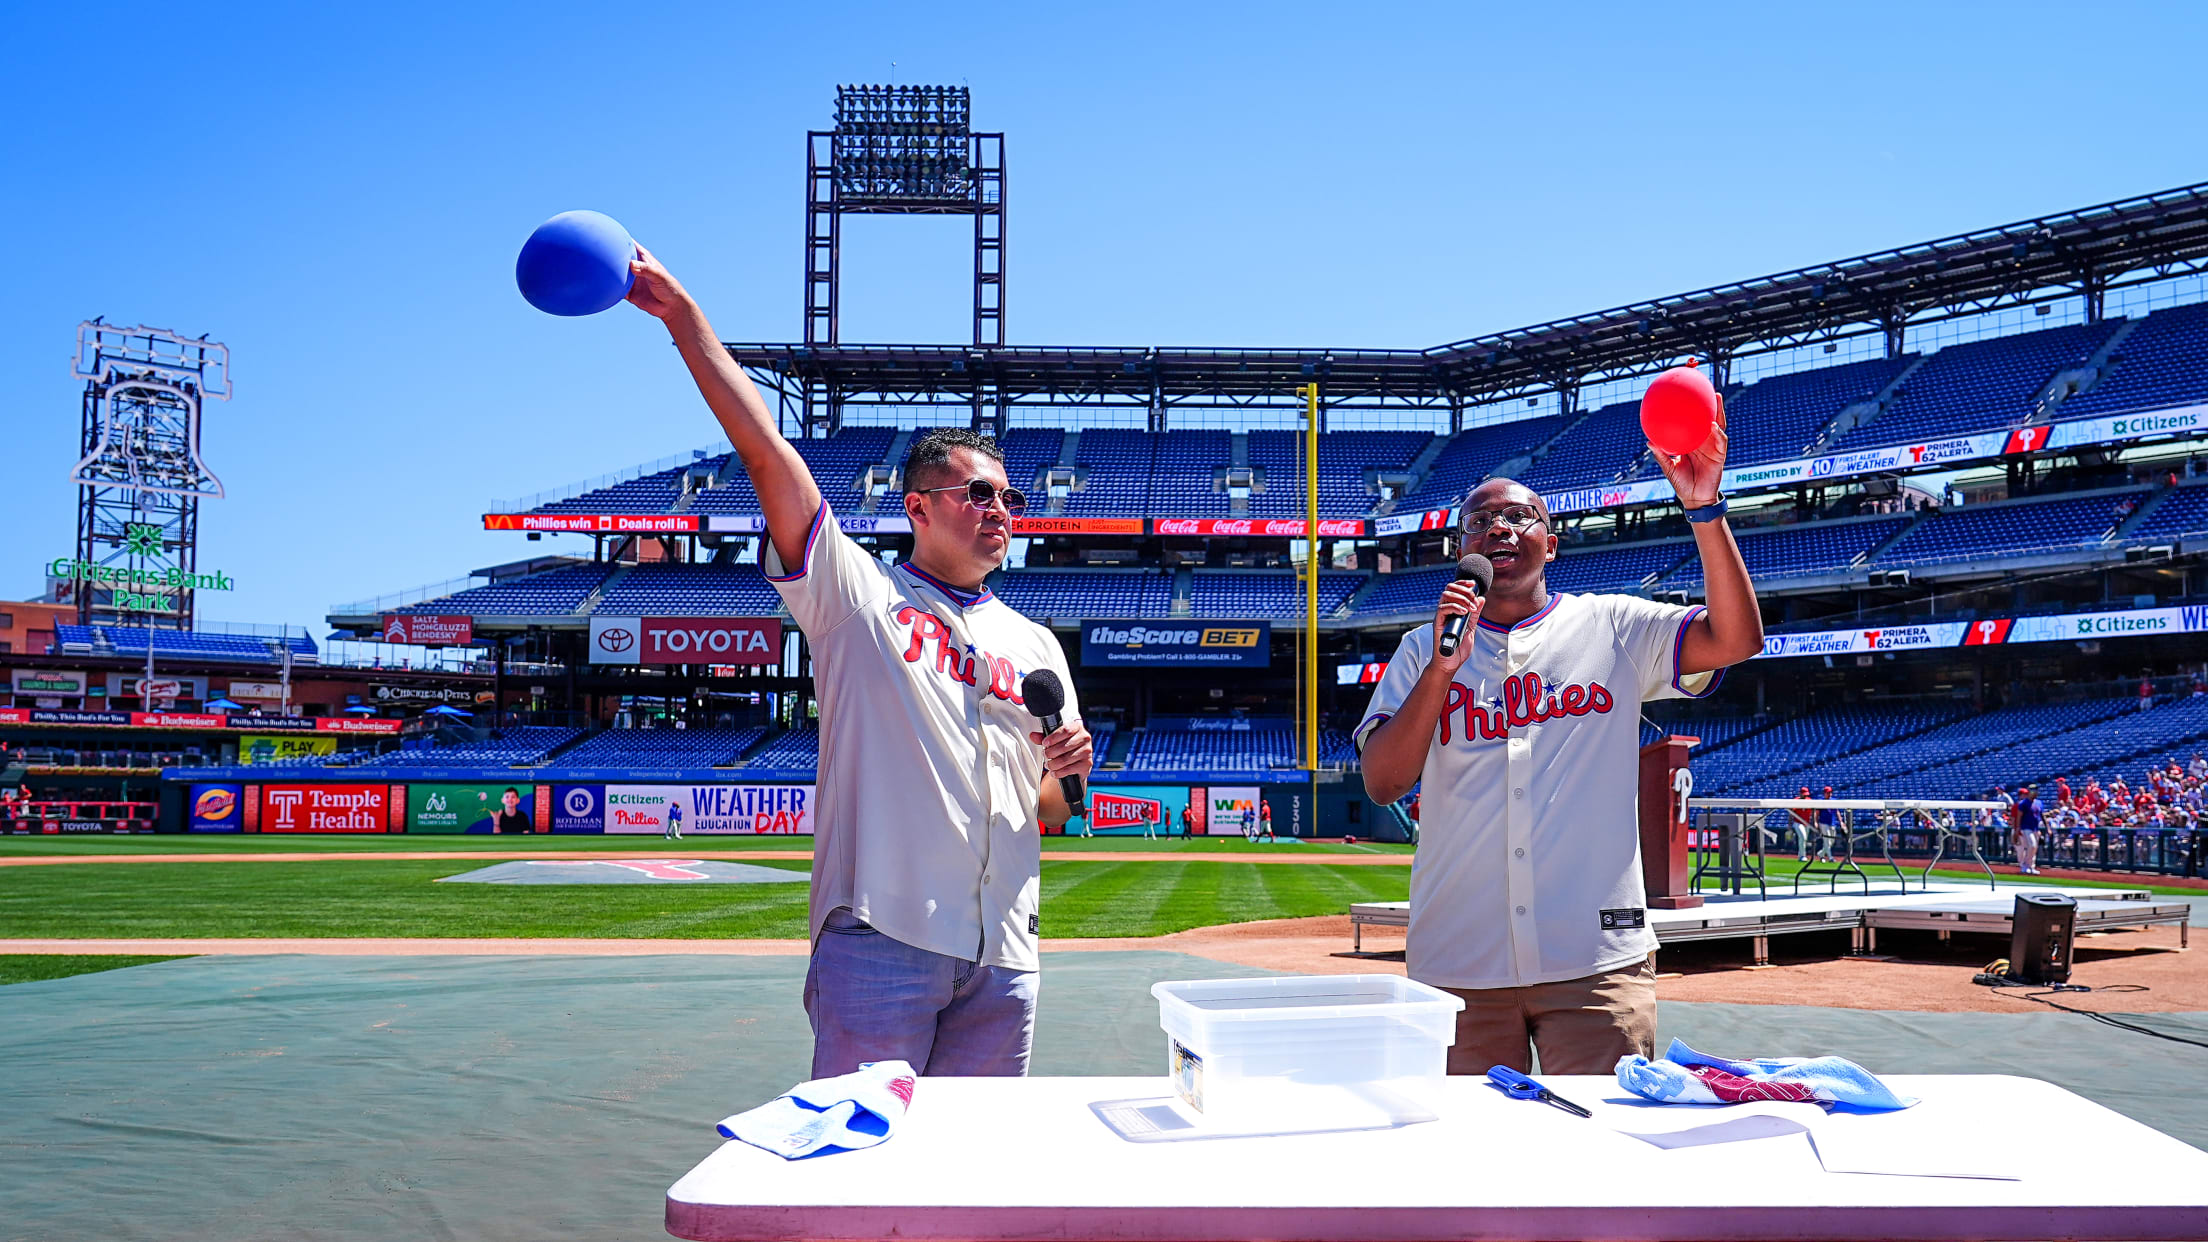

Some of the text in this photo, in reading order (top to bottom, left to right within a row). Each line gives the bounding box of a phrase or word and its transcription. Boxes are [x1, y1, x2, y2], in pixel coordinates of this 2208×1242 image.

[2130, 413, 2198, 433] Citizens
[1927, 440, 1970, 451] PRIMERA
[1839, 452, 1880, 463] FIRST ALERT
[1921, 453, 1936, 462] 62
[1937, 447, 1974, 457] ALERTA
[1812, 459, 1831, 475] 10
[1847, 457, 1896, 472] WEATHER
[1735, 467, 1802, 483] PRESENTED BY
[1546, 489, 1603, 513] WEATHER
[1603, 491, 1627, 507] DAY
[522, 516, 689, 530] Phillies win Deals roll in
[840, 518, 879, 529] KERY
[1028, 521, 1081, 531] PROTEIN
[1159, 519, 1200, 534] Coca-Cola
[1212, 519, 1253, 534] Coca-Cola
[1264, 519, 1305, 535] Coca-Cola
[1318, 519, 1357, 535] Coca-Cola
[52, 558, 230, 591] Citizens Bank
[112, 588, 171, 612] Park
[411, 623, 470, 632] MONGELUZZI
[412, 616, 438, 624] SALTZ
[2096, 616, 2167, 633] Citizens
[411, 631, 458, 640] BENDESKY
[1089, 626, 1256, 646] theScore BET
[1811, 633, 1833, 641] ALERT
[1882, 628, 1927, 637] PRIMERA
[648, 629, 770, 653] TOYOTA
[1799, 640, 1849, 653] WEATHER
[1876, 639, 1893, 649] 62
[1893, 635, 1931, 645] ALERTA
[896, 606, 1024, 706] Phill
[1108, 653, 1136, 661] Gambling
[1439, 671, 1614, 747] Phillies
[160, 715, 217, 727] Budweiser
[343, 720, 394, 731] Budweiser
[282, 740, 315, 752] PLAY
[309, 790, 381, 812] Temple
[574, 797, 585, 808] R
[620, 794, 665, 805] Citizens
[691, 787, 807, 818] WEATHER
[1214, 799, 1253, 811] WM
[614, 810, 659, 825] Phillies
[1097, 800, 1149, 821] HERR'
[62, 822, 103, 831] TOYOTA
[309, 811, 376, 829] Health
[555, 816, 602, 825] ROTHMAN
[694, 819, 751, 831] EDUCATION
[754, 810, 805, 834] DAY
